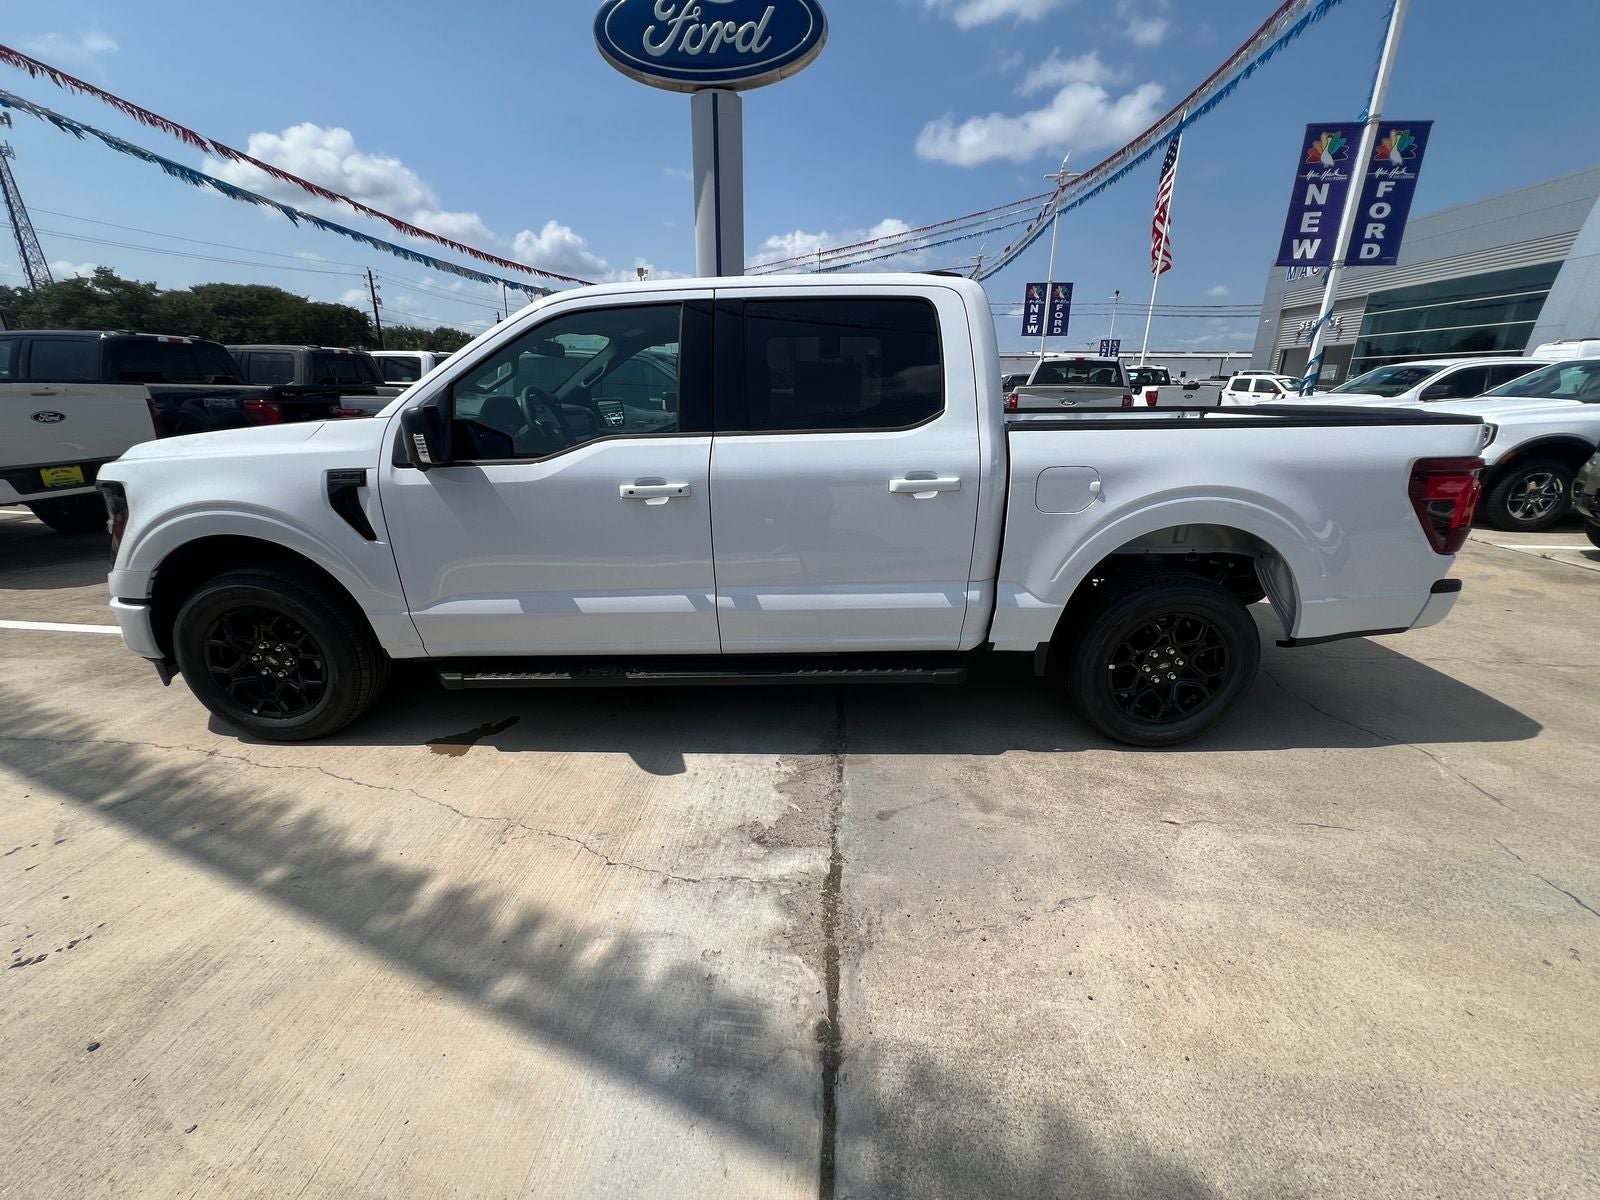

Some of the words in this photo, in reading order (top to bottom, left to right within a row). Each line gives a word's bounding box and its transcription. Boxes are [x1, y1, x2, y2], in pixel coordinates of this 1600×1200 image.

[643, 0, 776, 56] Ford
[1292, 183, 1330, 260] NEW
[1359, 181, 1396, 259] FORD
[1027, 304, 1039, 334] NEW
[1053, 304, 1064, 334] FORD
[1299, 316, 1342, 330] SERCE
